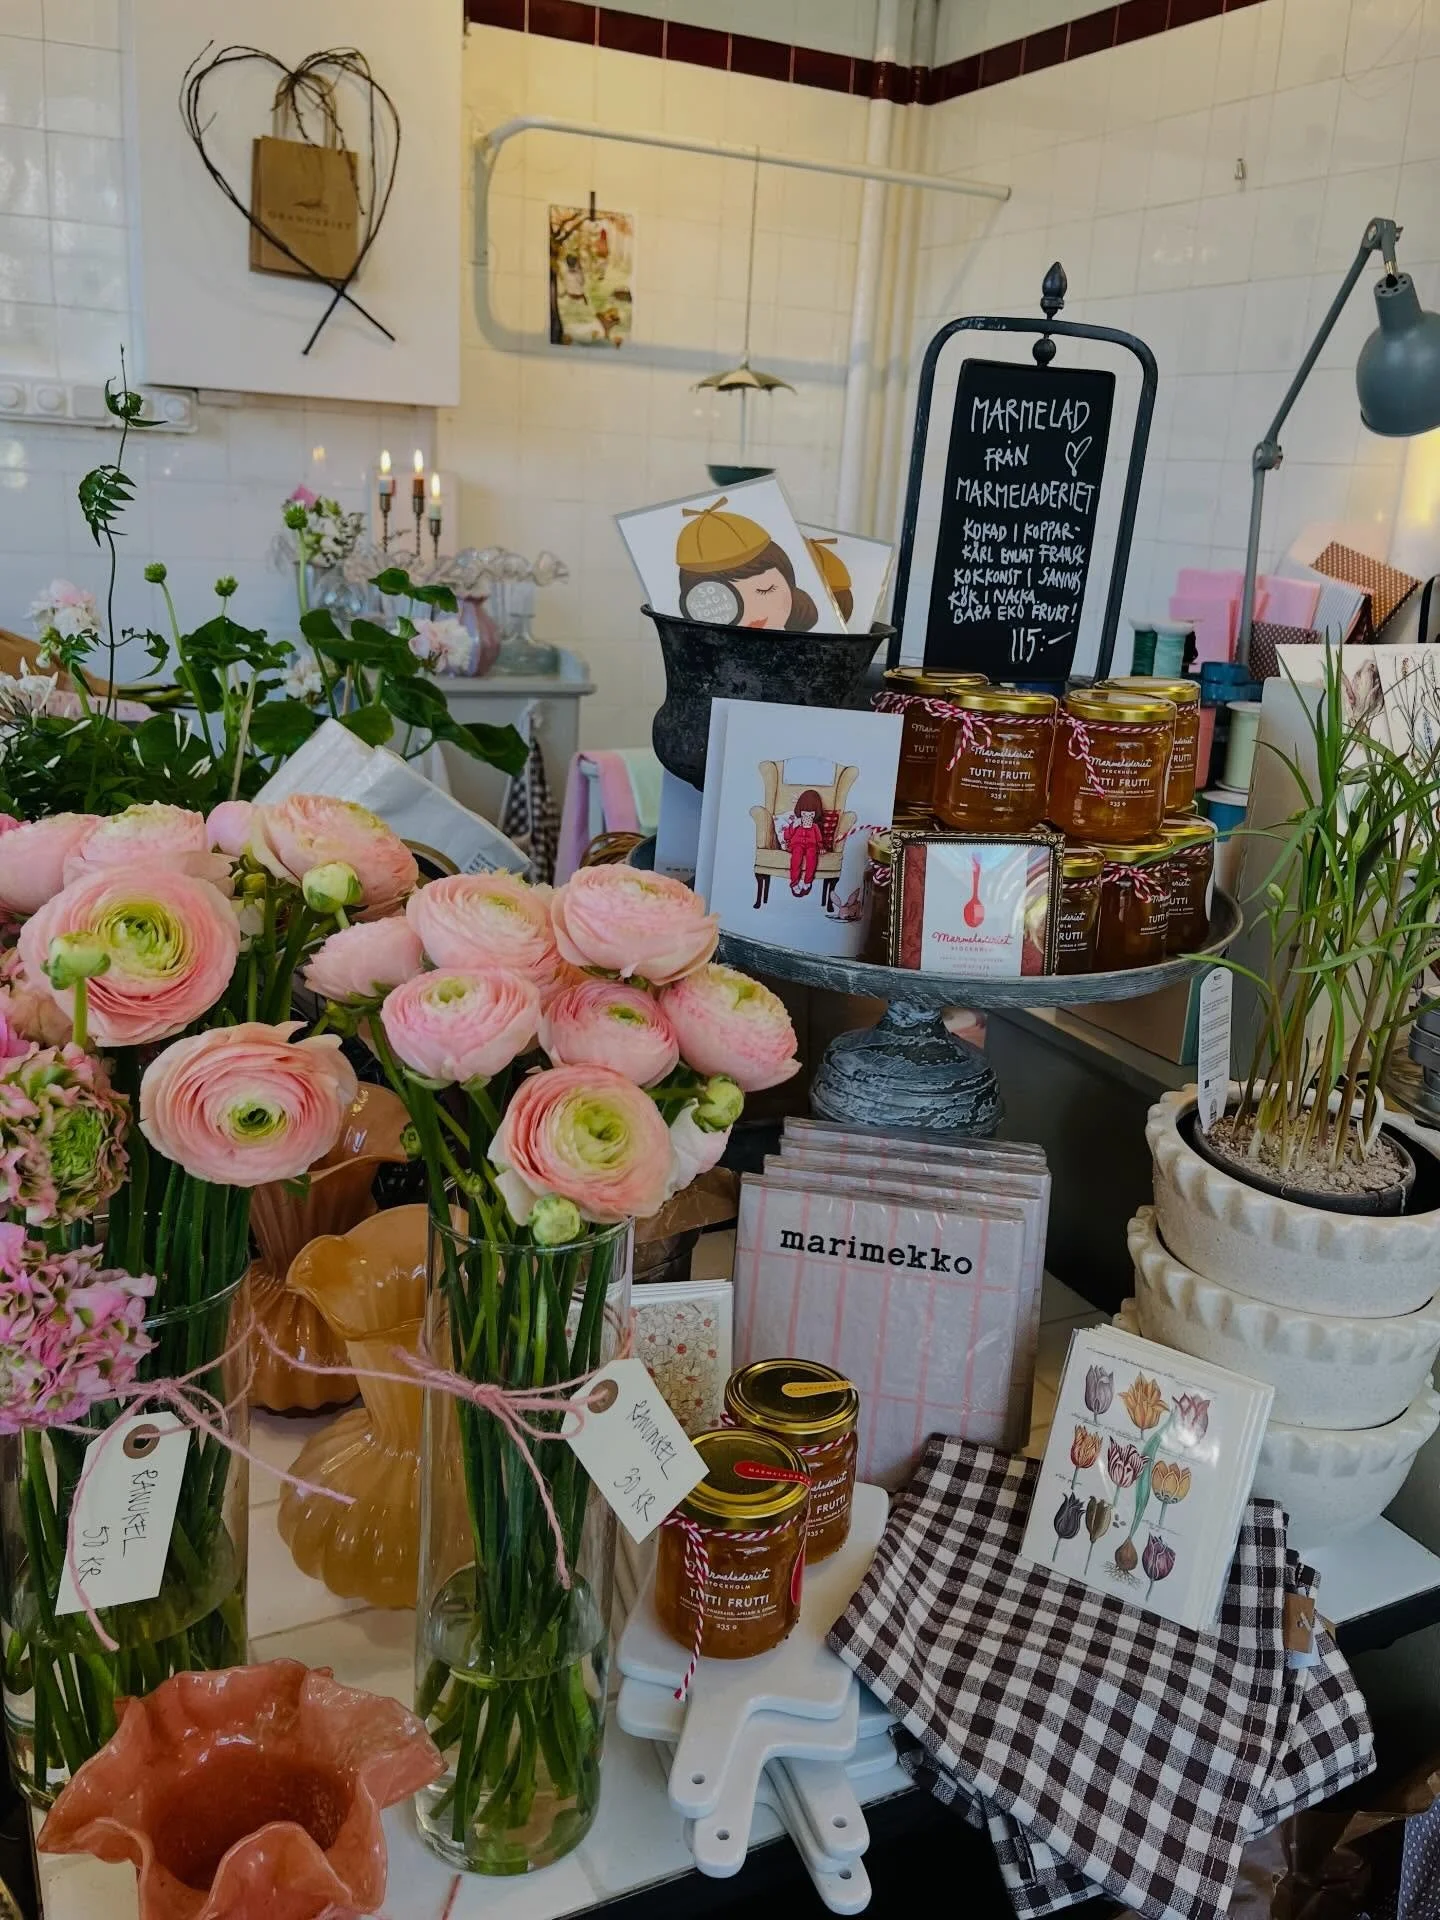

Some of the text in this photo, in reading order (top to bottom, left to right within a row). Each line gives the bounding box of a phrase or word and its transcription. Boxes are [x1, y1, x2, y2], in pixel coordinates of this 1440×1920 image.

[971, 396, 1090, 434] MARMELAD
[984, 440, 1029, 472] FRÅN
[956, 477, 1095, 515] MARMELADERIET
[963, 517, 1080, 544] KOKAD I KOPPAR-
[962, 540, 993, 564] KÄRL
[953, 567, 1022, 587] KOKKONST
[1028, 567, 1032, 587] I
[984, 590, 989, 604] I
[953, 604, 991, 624] BARA
[997, 604, 1024, 620] EKO
[969, 767, 1031, 780] TUTTI FRUTTI
[1087, 775, 1150, 787] TTTI FRUTTI
[1059, 931, 1083, 940] RUTTI
[780, 1230, 972, 1275] marimekko
[632, 1488, 656, 1521] KR
[817, 1494, 846, 1514] FRUTTI
[79, 1557, 104, 1584] KR
[728, 1594, 770, 1608] FRUTTI
